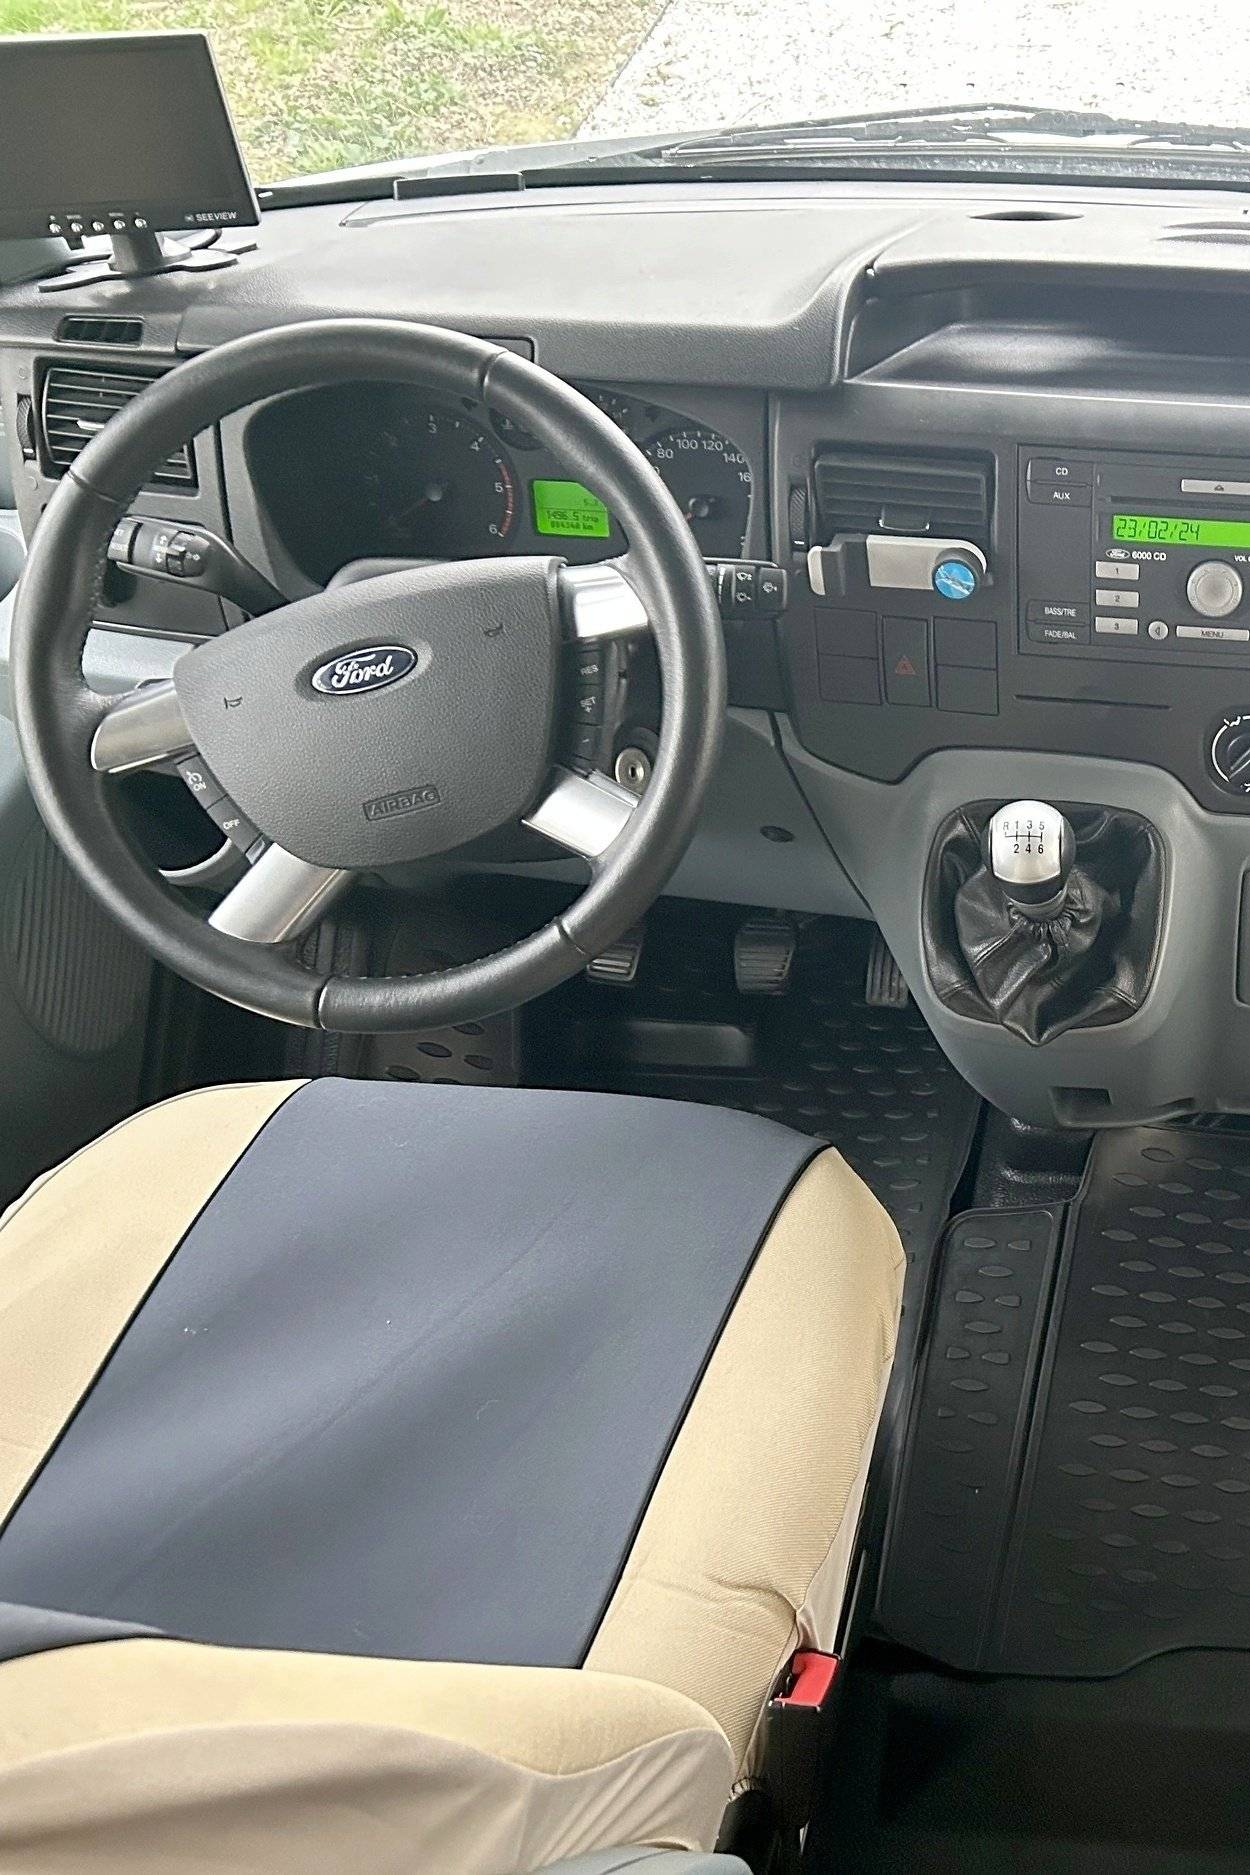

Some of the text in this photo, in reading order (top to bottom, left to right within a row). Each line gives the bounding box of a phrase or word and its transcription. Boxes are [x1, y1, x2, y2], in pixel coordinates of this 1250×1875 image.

[196, 211, 237, 221] SEEVIEW
[428, 423, 438, 433] 3
[470, 441, 480, 451] 4
[676, 438, 699, 450] 100
[702, 440, 724, 451] 120
[656, 449, 674, 459] 80
[723, 453, 745, 464] 140
[737, 472, 752, 482] 16
[1055, 467, 1069, 476] CD
[495, 482, 504, 493] 5
[1053, 491, 1071, 500] AUX
[488, 524, 498, 534] 6
[1116, 517, 1201, 542] 23/02/24
[1131, 551, 1152, 560] 6000
[1153, 552, 1167, 561] CD
[1234, 554, 1247, 563] VOL
[1044, 606, 1077, 617] BASS/TRE
[1044, 629, 1078, 640] FADE/BAL
[1201, 630, 1224, 638] MENU
[331, 653, 394, 689] Ford
[193, 781, 207, 792] ON
[370, 789, 436, 816] AIRBAG
[223, 818, 240, 830] OFF
[1026, 820, 1033, 829] 3
[1039, 821, 1045, 831] 5
[1013, 843, 1044, 854] 2 4 6
